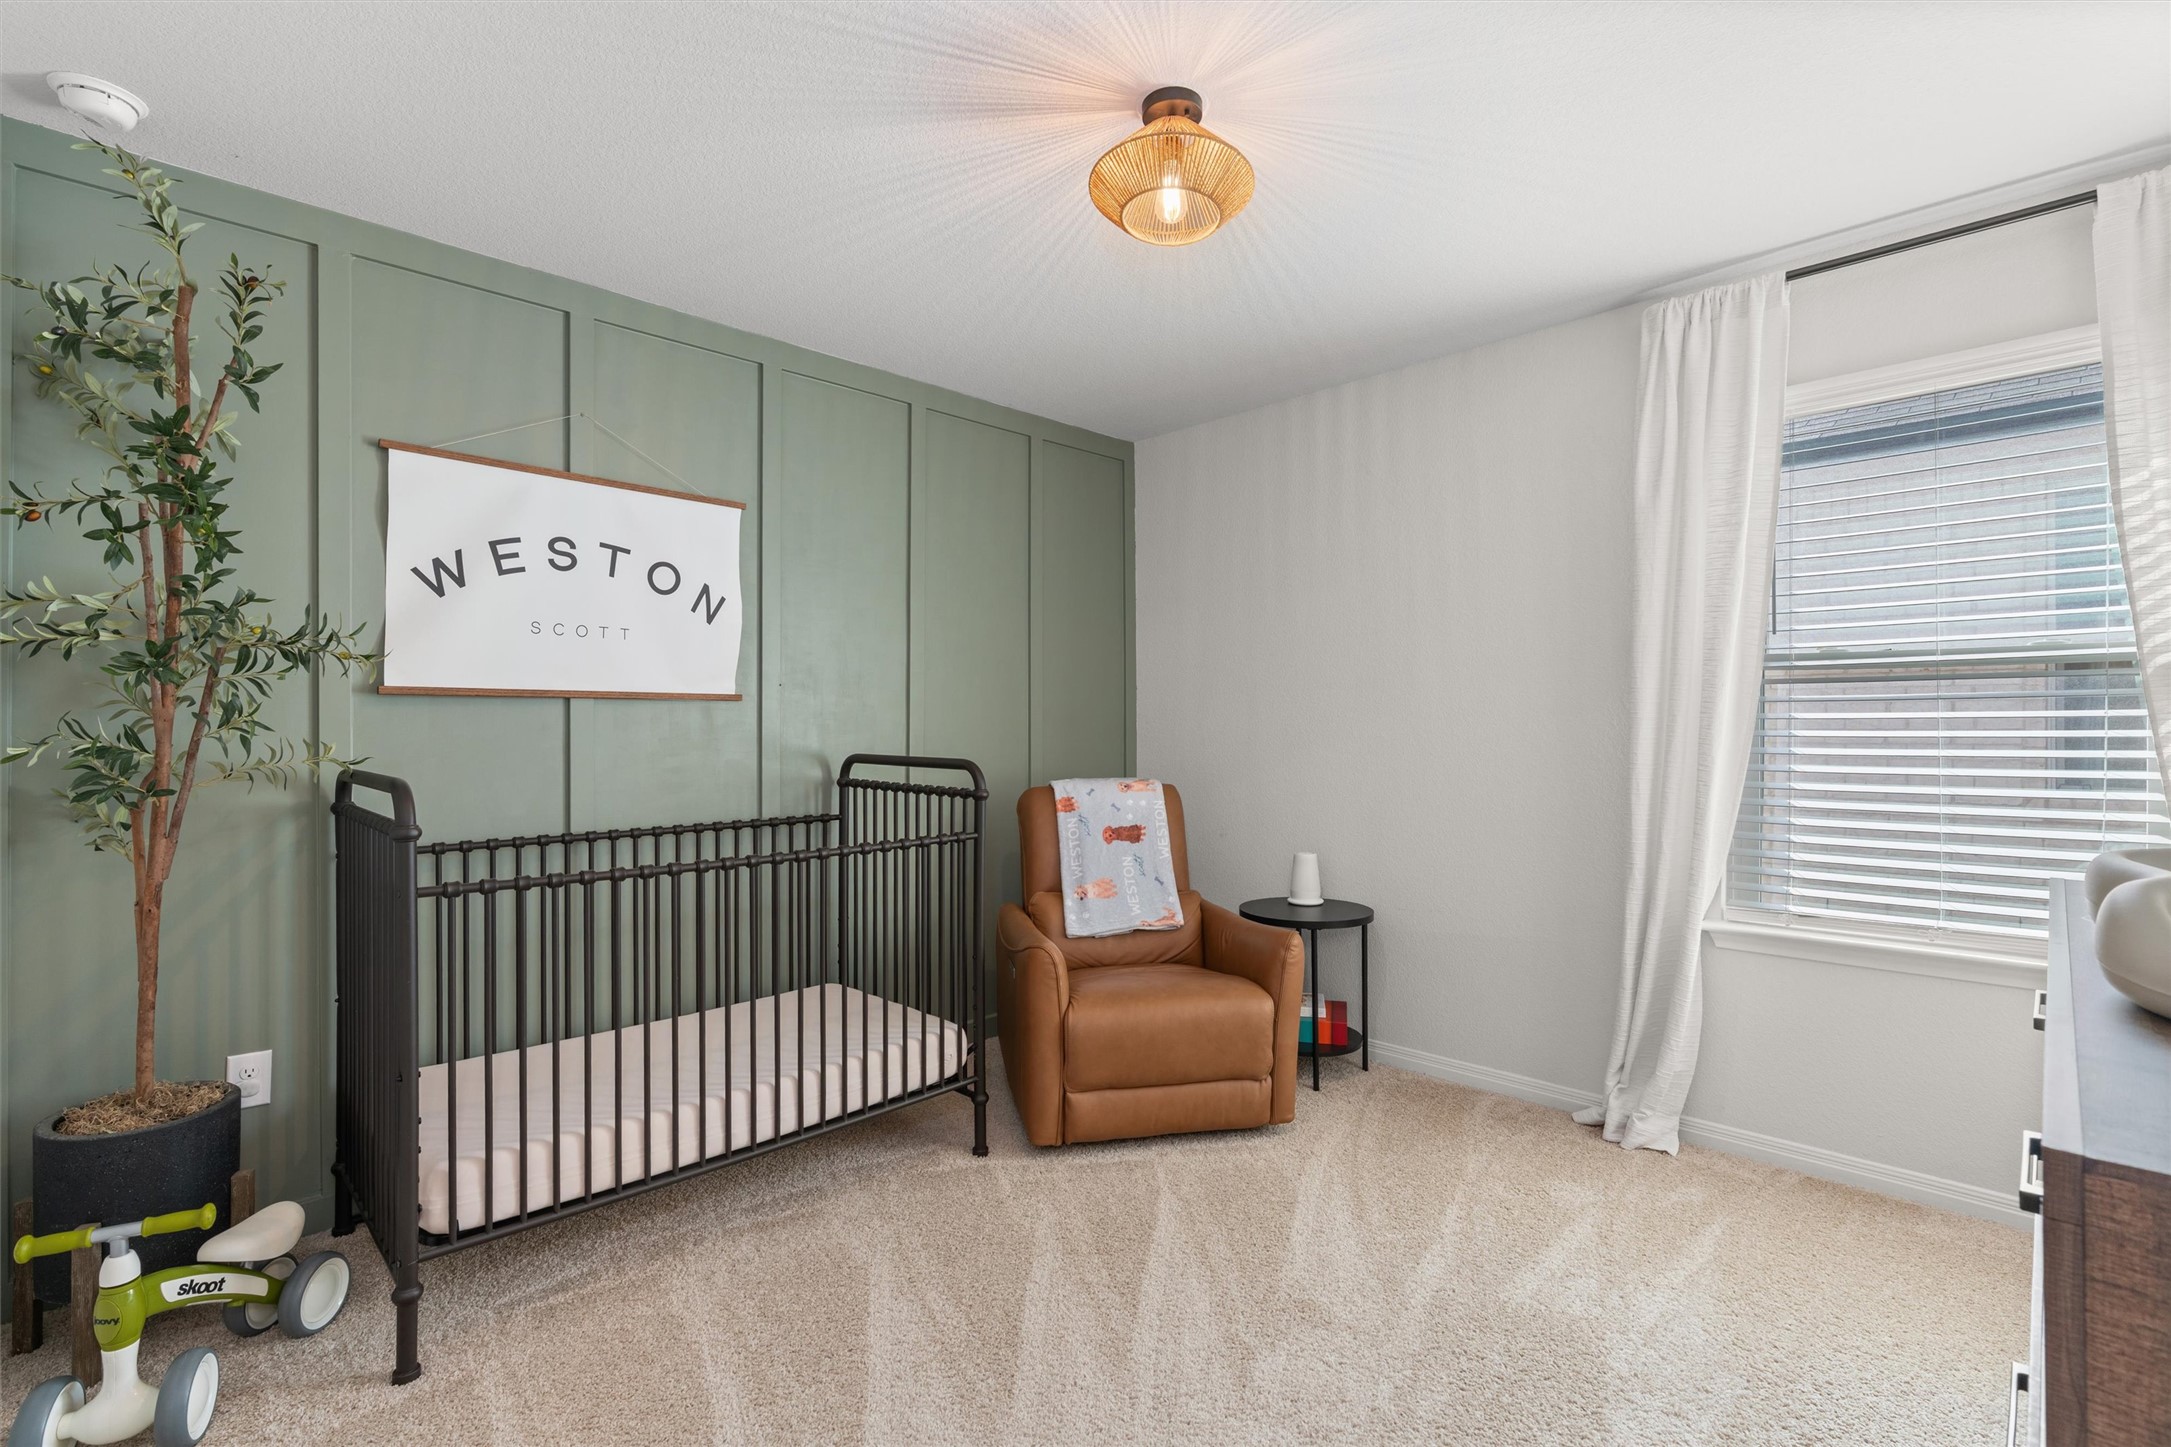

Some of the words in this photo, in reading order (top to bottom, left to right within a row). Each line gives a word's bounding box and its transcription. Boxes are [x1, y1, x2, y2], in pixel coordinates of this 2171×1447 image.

[410, 536, 726, 625] WESTON
[530, 621, 629, 640] SCOTT
[1067, 818, 1083, 879] WESTON
[1155, 800, 1170, 859] WESTON
[1122, 856, 1141, 915] WESTON
[177, 1277, 226, 1296] skoot
